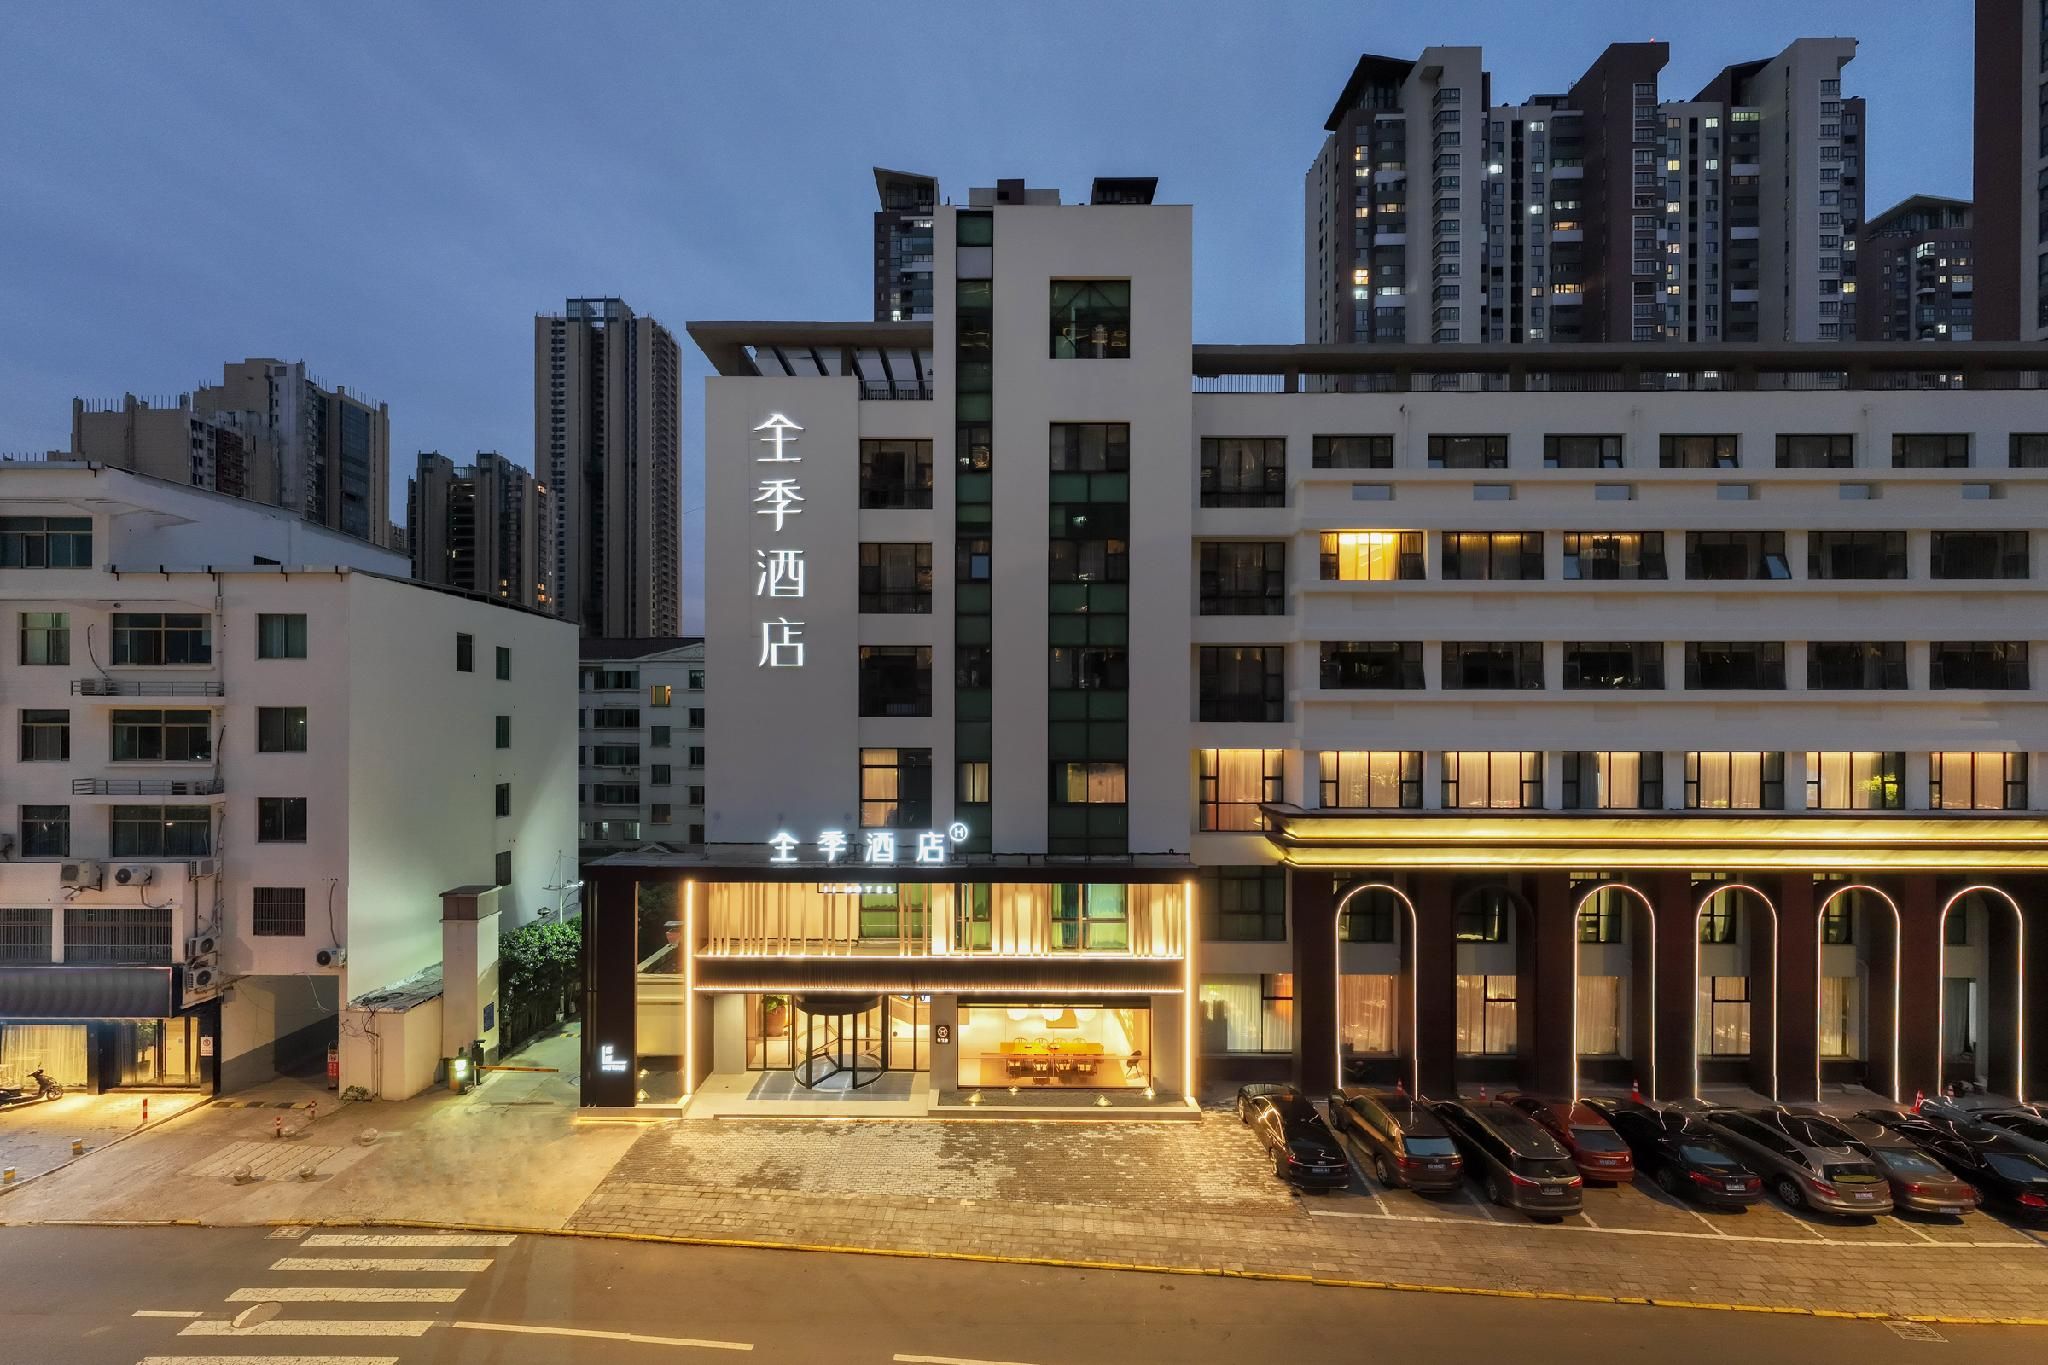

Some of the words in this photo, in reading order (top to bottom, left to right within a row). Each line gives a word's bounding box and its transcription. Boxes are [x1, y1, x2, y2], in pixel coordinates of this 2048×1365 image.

[753, 414, 805, 667] 全季酒店
[769, 830, 945, 863] 全季酒店
